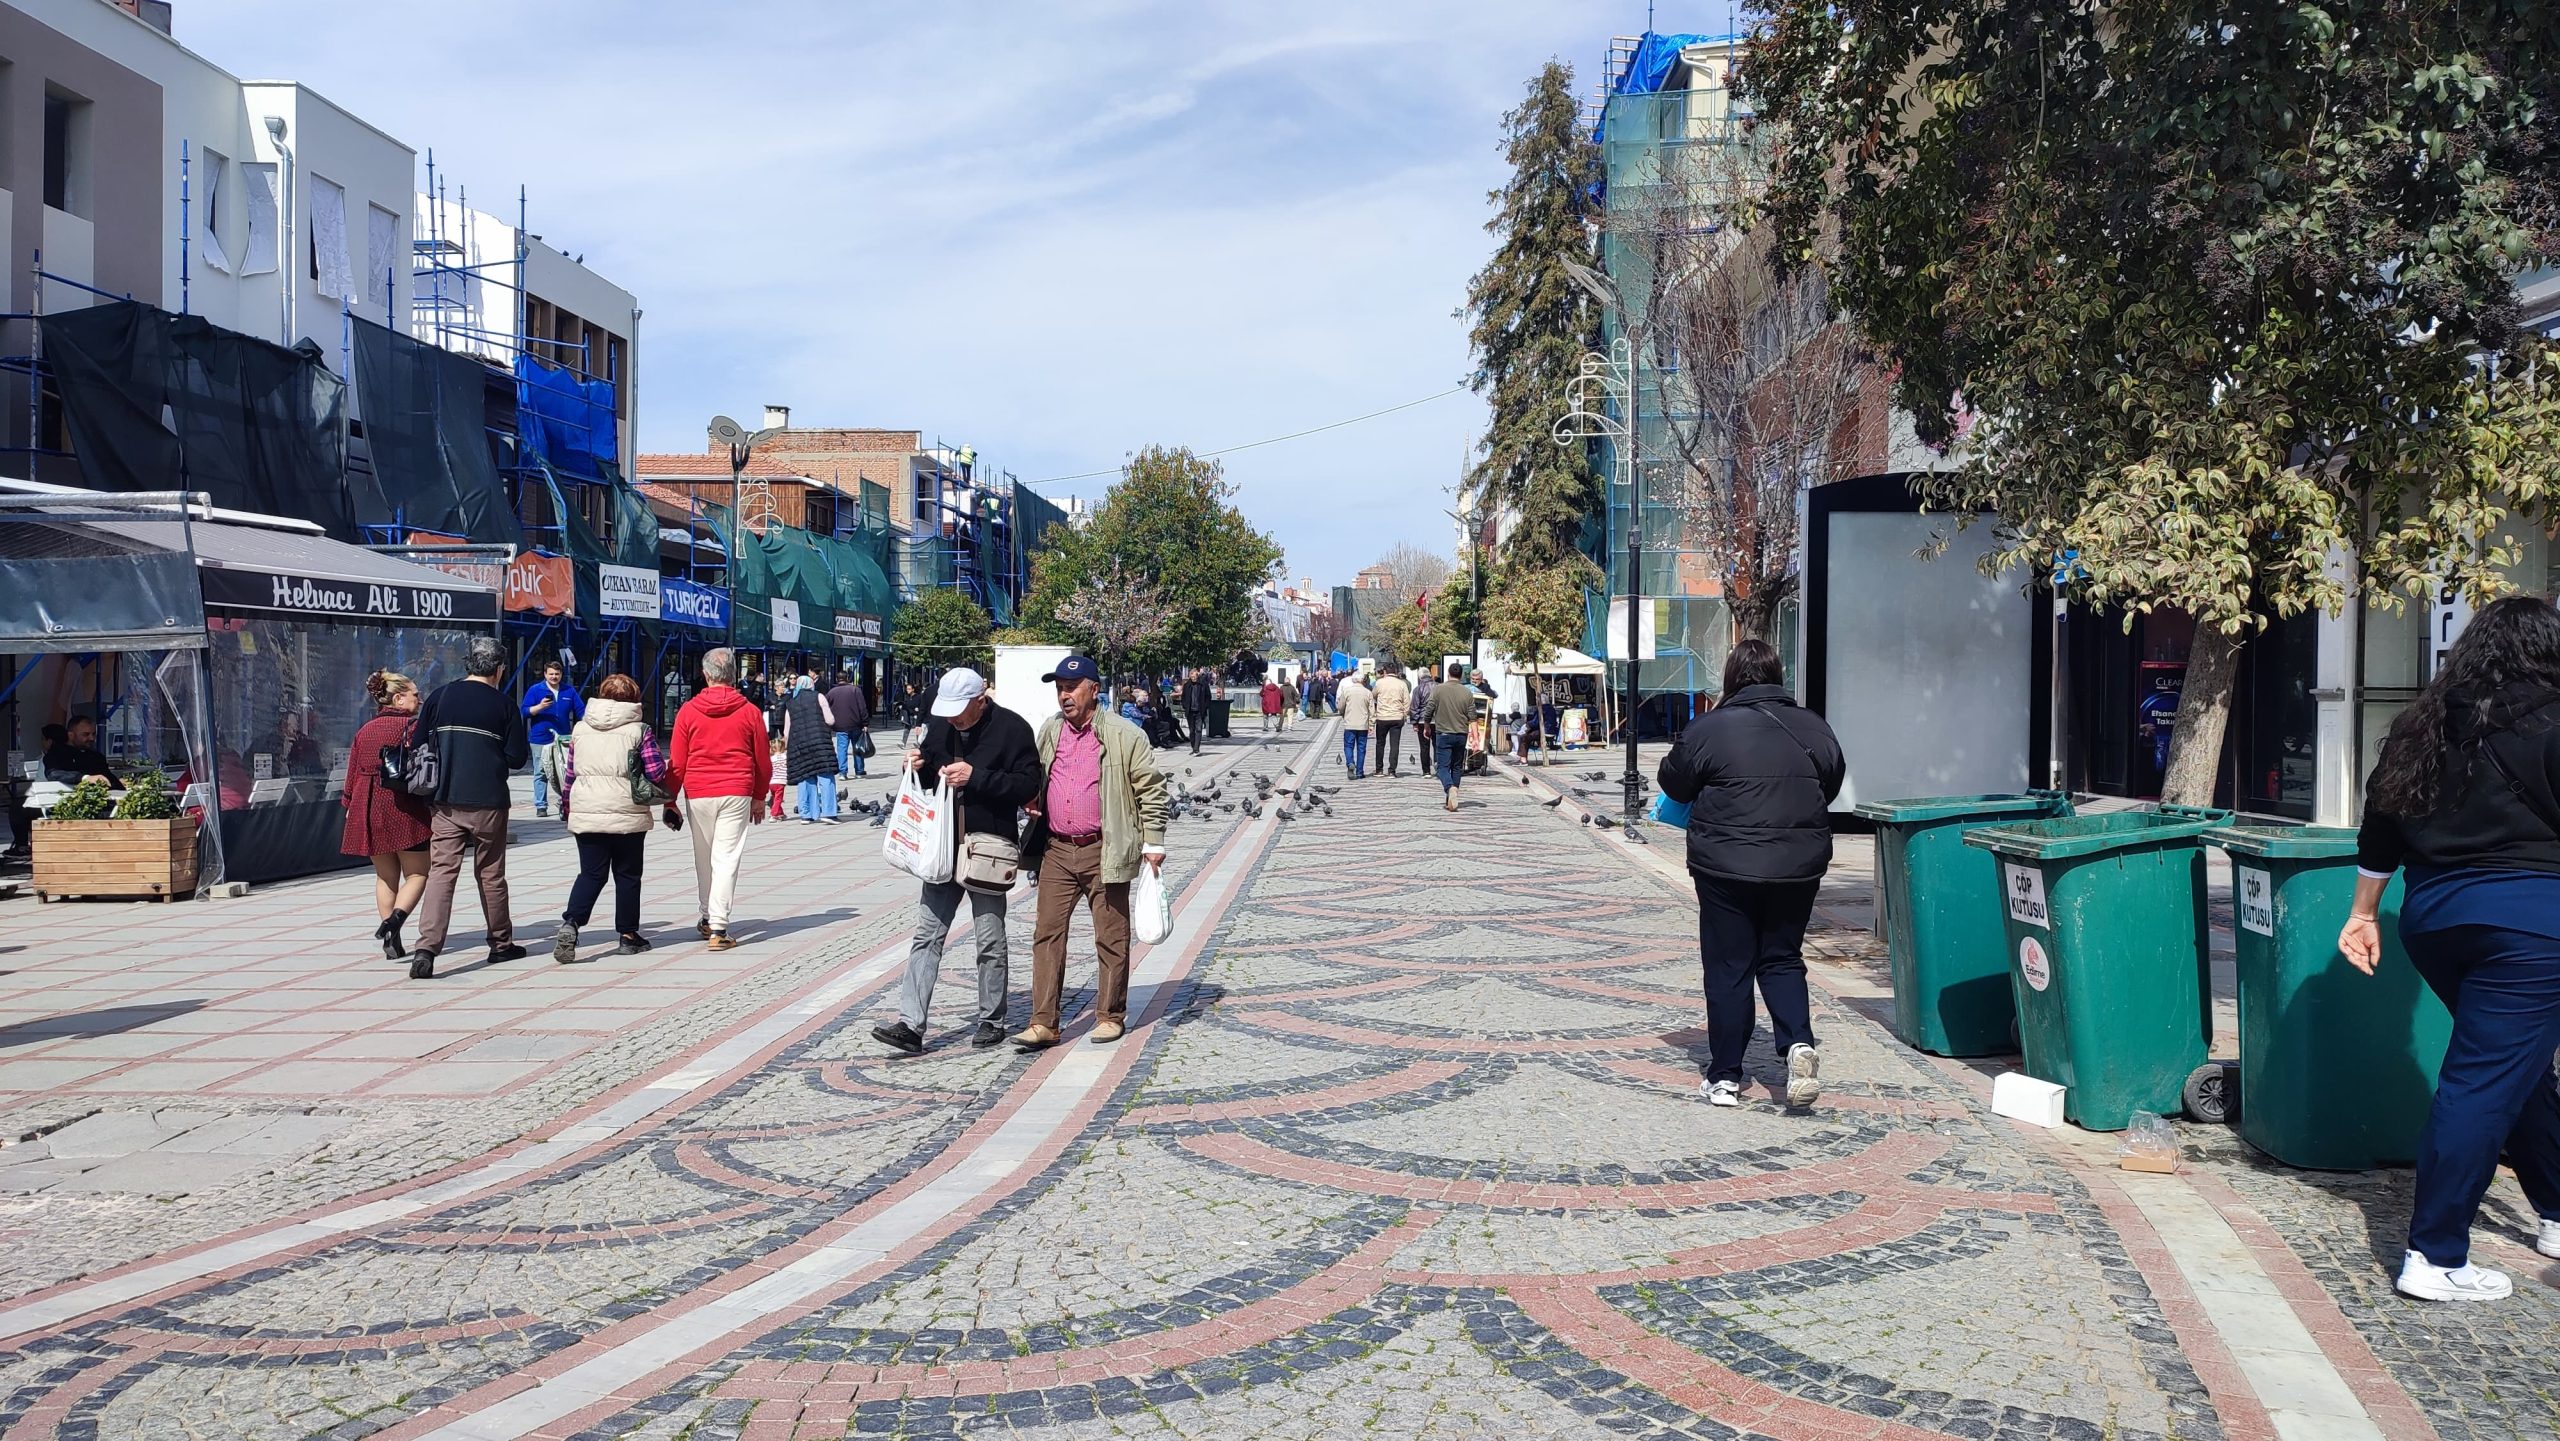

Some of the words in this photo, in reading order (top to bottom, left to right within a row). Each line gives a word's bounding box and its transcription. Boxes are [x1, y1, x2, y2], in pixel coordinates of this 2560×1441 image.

[505, 564, 543, 599] ptik
[272, 575, 355, 611] Helvacı
[366, 584, 400, 614] Ali
[412, 589, 452, 616] 1900
[666, 588, 720, 619] TURKCELL
[835, 615, 862, 632] ZEHRA
[2155, 677, 2182, 687] CLEAR
[2015, 873, 2032, 896] ÇÖP
[2247, 875, 2261, 902] ÇÖP
[2011, 896, 2045, 919] KUTUSU
[2242, 903, 2270, 928] KUTUSU
